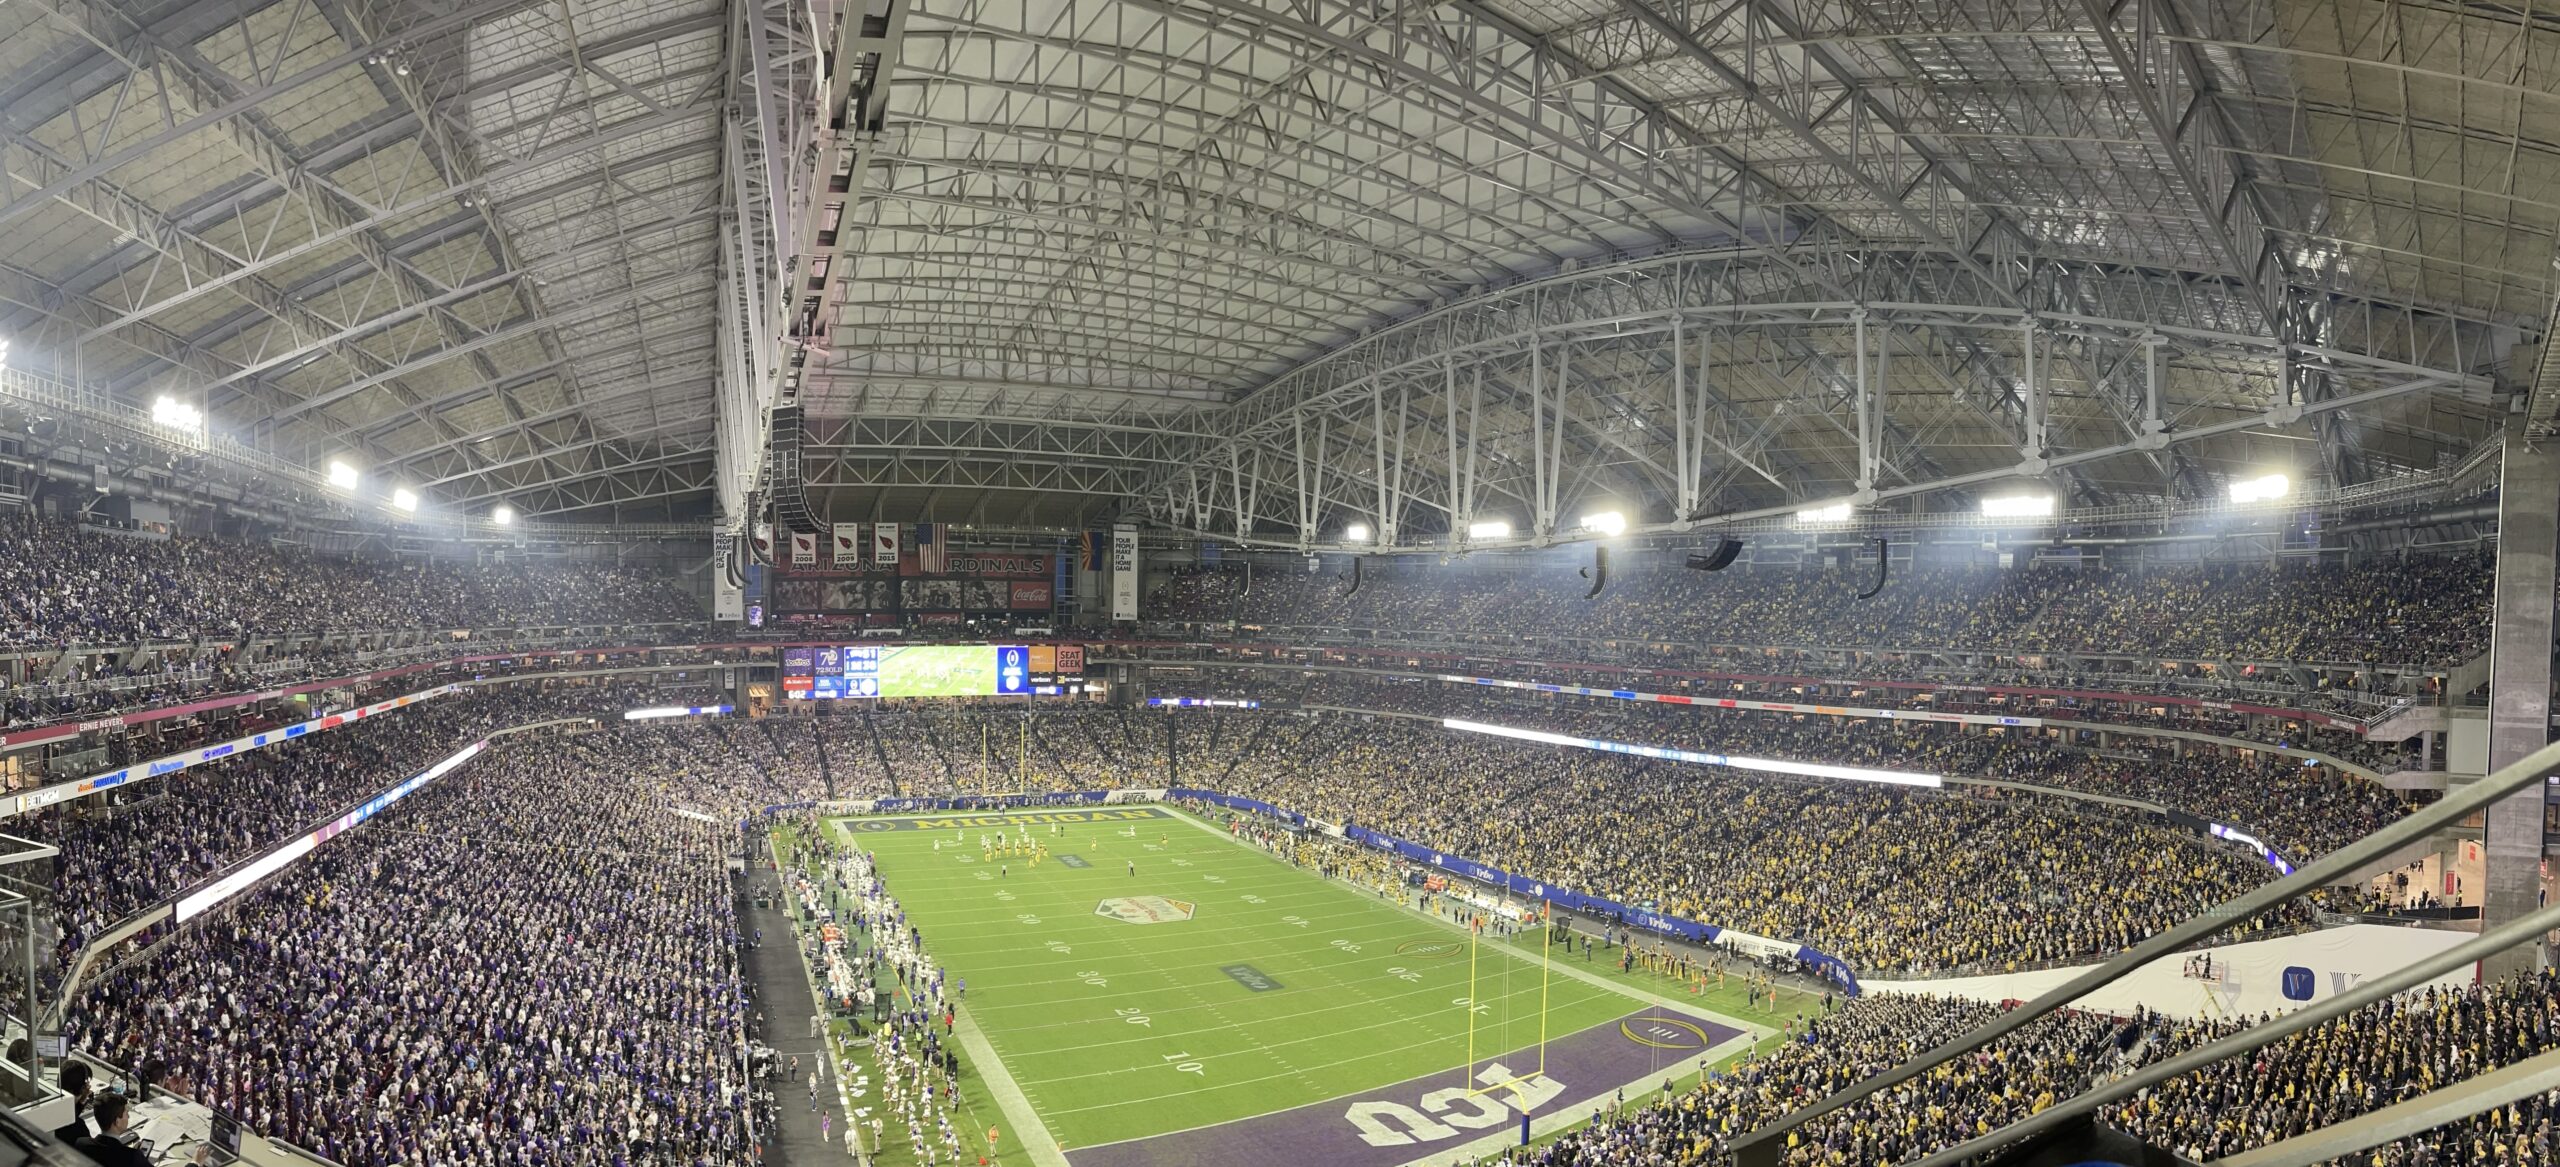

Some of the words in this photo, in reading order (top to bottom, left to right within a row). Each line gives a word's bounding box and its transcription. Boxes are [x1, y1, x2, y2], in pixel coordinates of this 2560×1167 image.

[789, 558, 894, 572] ARIZONA
[944, 558, 1044, 573] RDINALS
[1060, 651, 1081, 660] SEAT
[1059, 660, 1081, 668] GEEK
[79, 720, 99, 732] ERNIE
[99, 717, 125, 729] NEVERS
[914, 810, 1152, 829] MICHIGAN
[1378, 836, 1393, 849] Vrbo
[1476, 867, 1495, 881] Vrbo
[1648, 916, 1673, 931] Vrbo
[1076, 970, 1108, 988] 30
[1387, 966, 1423, 983] 20
[1452, 997, 1492, 1016] 10
[1114, 1007, 1151, 1028] 20
[1162, 1051, 1205, 1077] 10
[1344, 1062, 1567, 1147] TCU
